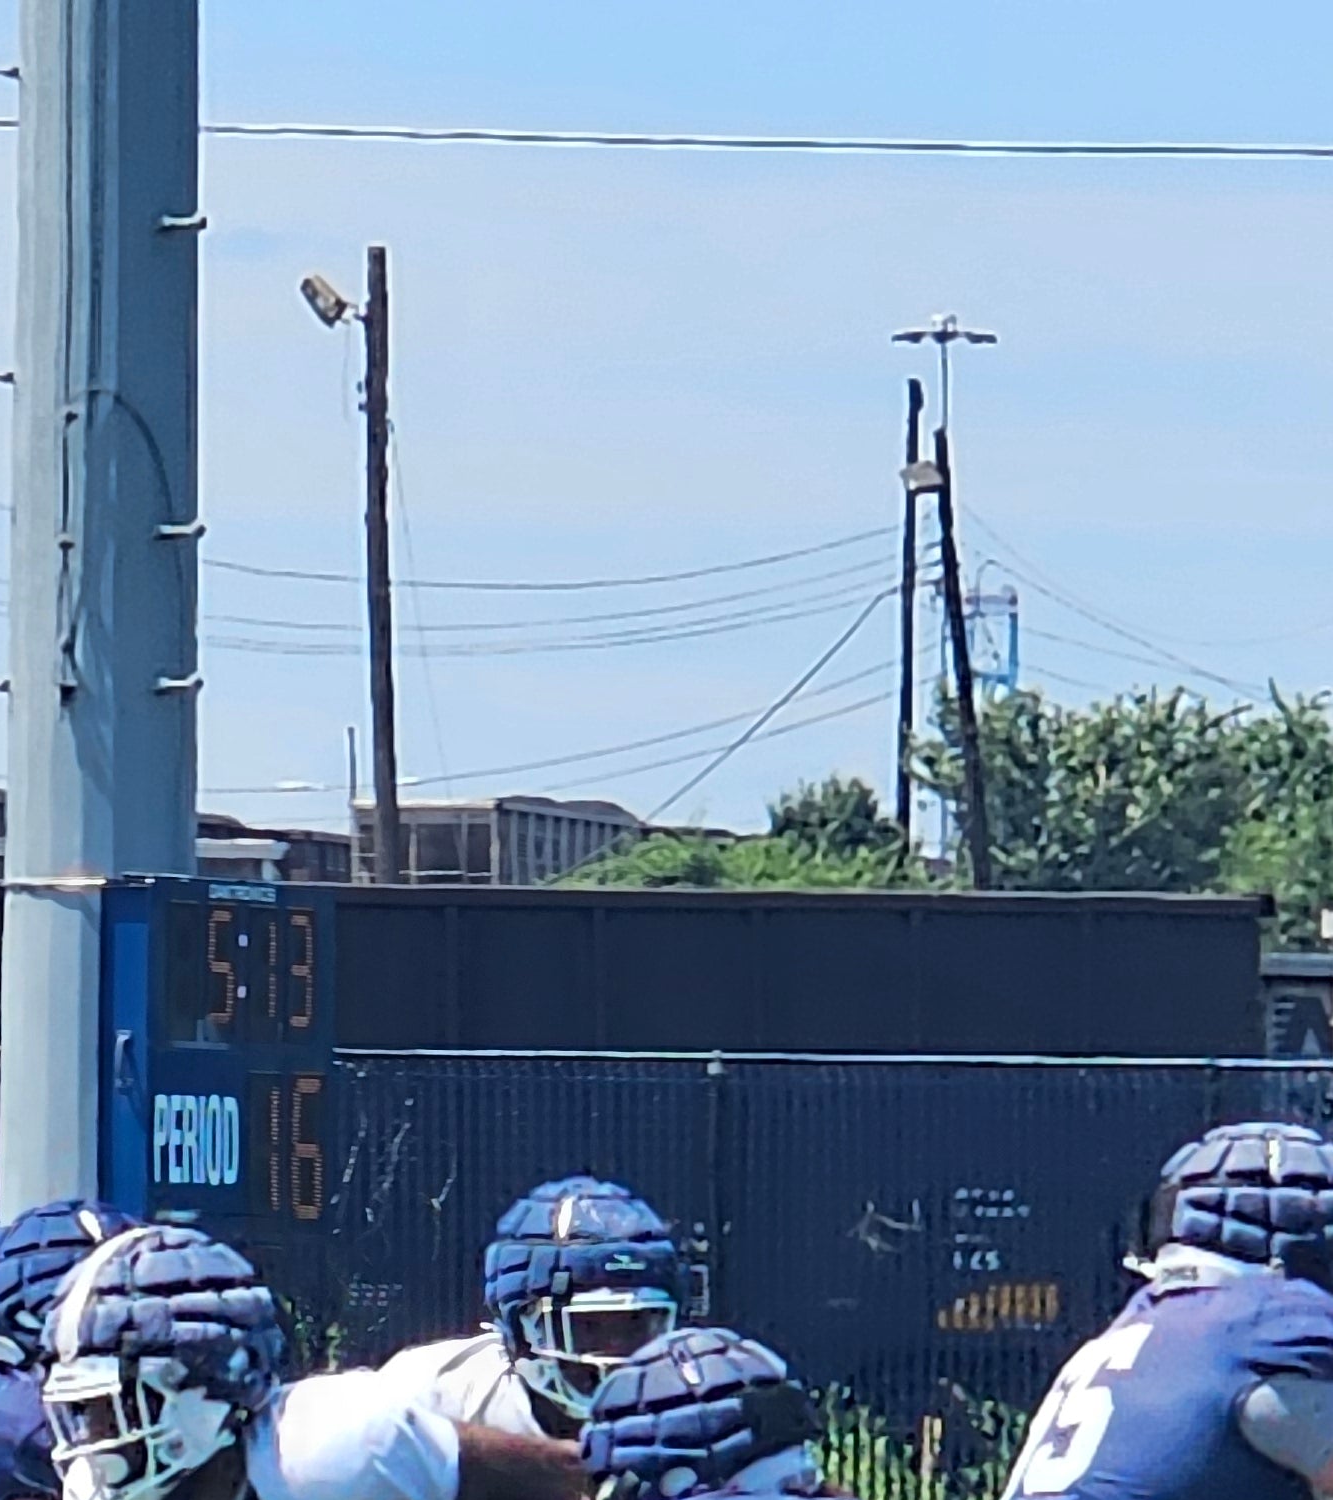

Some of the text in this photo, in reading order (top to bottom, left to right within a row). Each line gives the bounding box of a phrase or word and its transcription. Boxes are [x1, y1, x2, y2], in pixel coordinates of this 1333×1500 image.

[208, 910, 313, 1027] 5:13
[153, 1094, 240, 1186] PERIOD
[270, 1078, 323, 1220] 16
